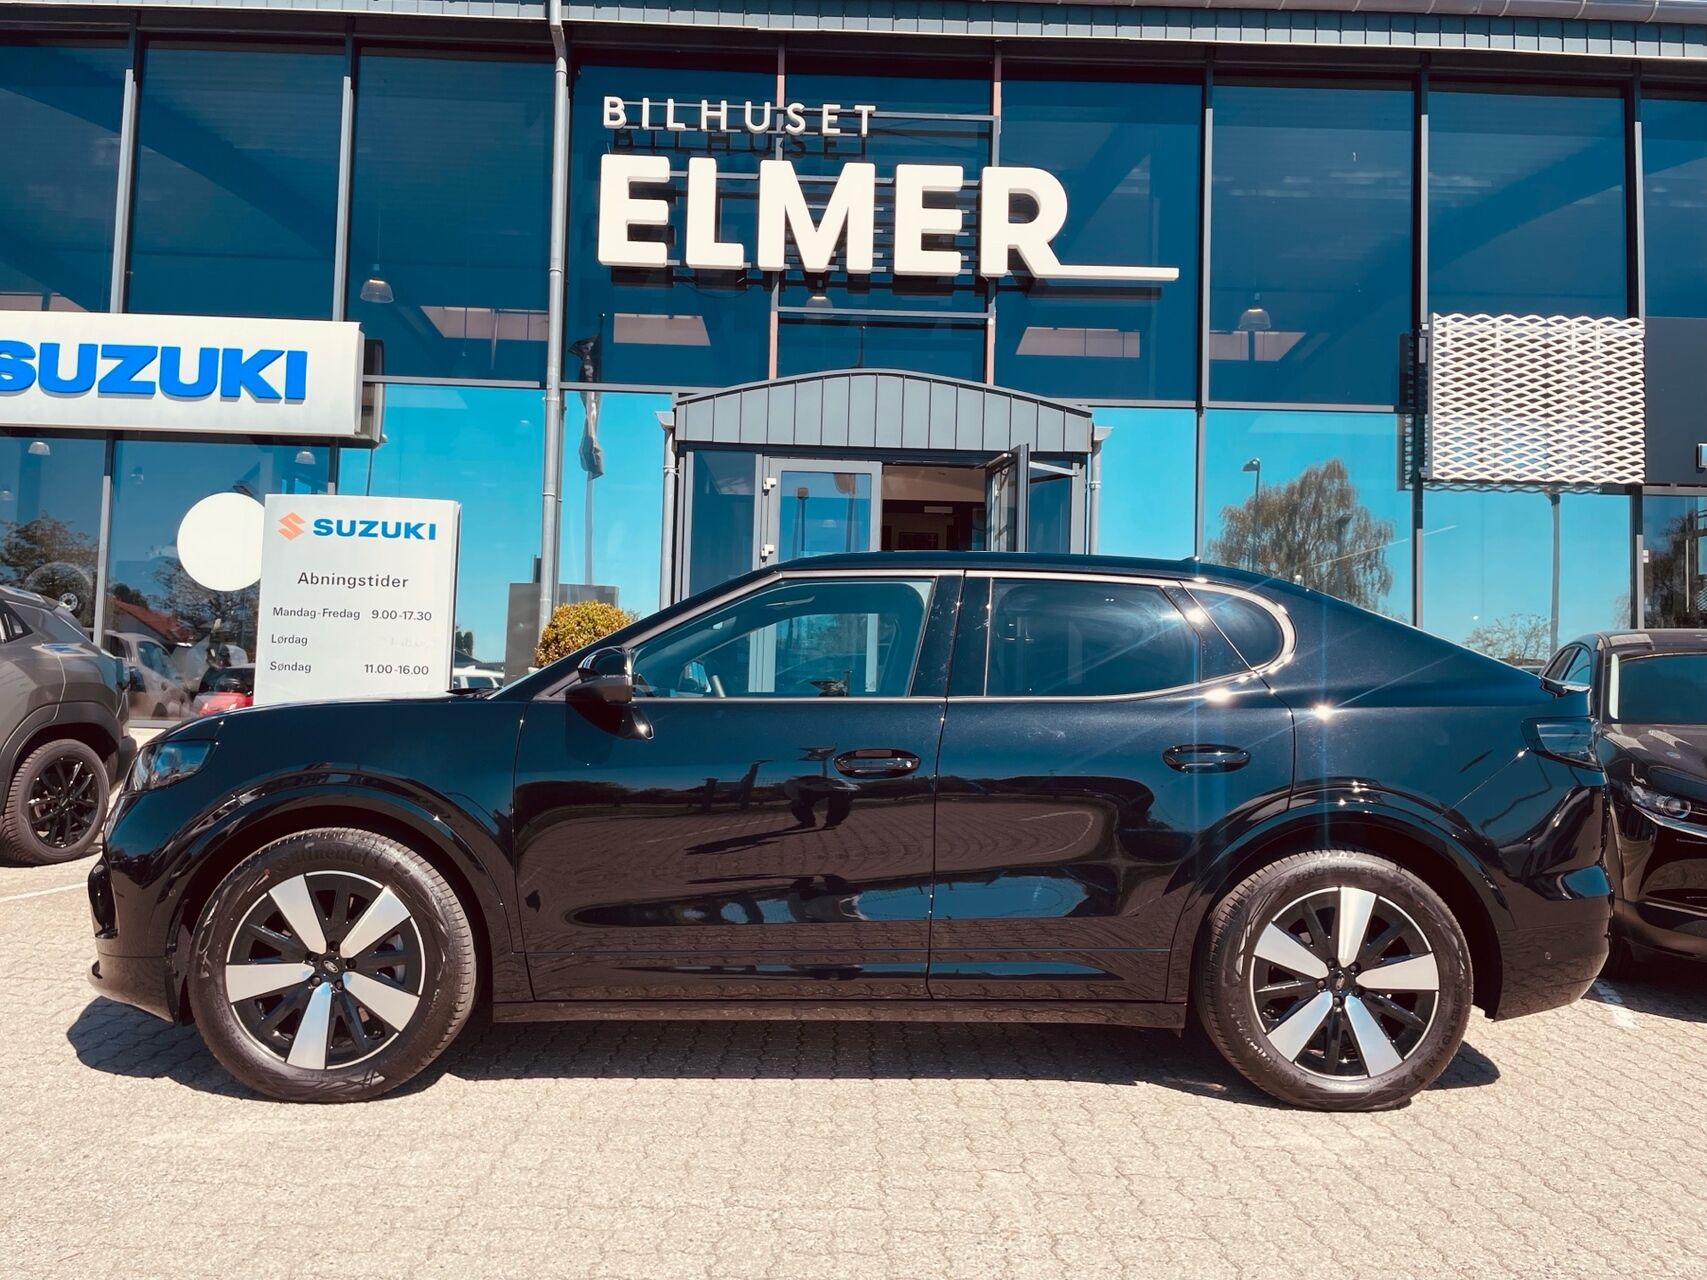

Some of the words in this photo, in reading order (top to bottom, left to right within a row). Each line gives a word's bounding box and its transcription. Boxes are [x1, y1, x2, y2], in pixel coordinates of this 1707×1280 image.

[603, 96, 876, 137] BILHUSET
[598, 153, 1179, 281] ELMER
[0, 340, 308, 401] SUZUKI
[313, 518, 437, 541] SUZUKI
[297, 571, 409, 589] Abningstider
[271, 633, 308, 646] Lørdag
[269, 661, 312, 674] Søndag
